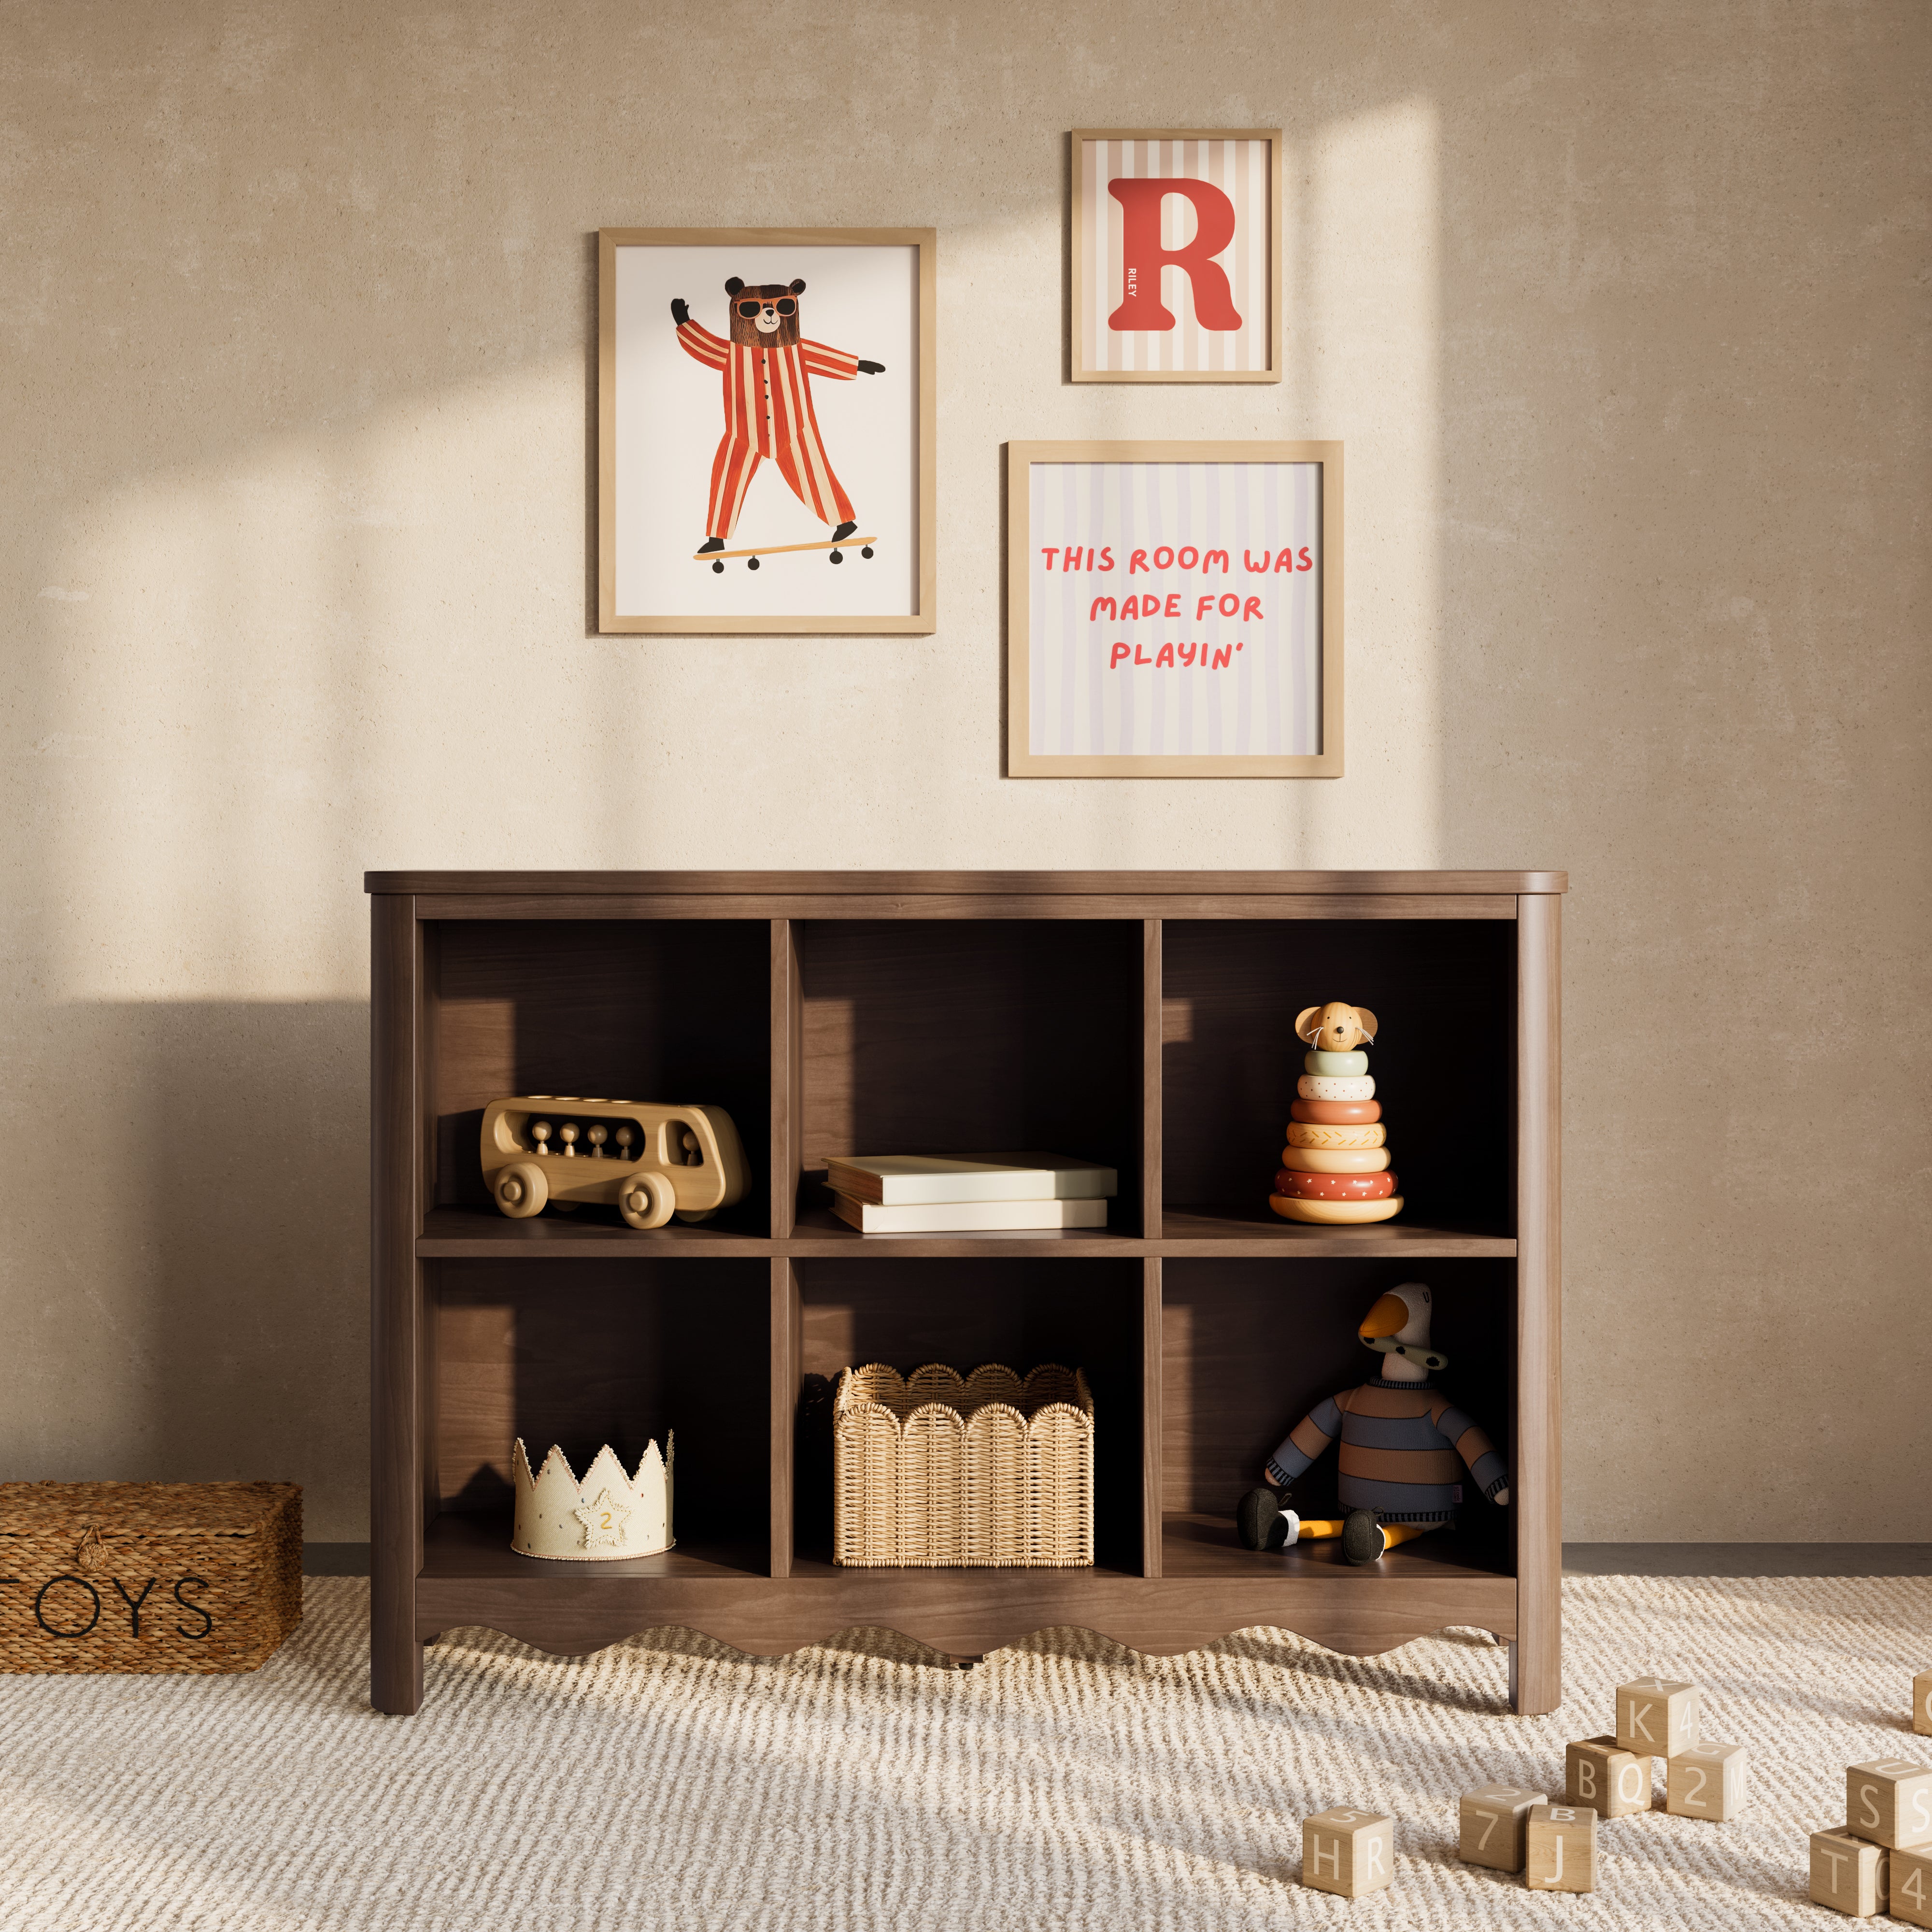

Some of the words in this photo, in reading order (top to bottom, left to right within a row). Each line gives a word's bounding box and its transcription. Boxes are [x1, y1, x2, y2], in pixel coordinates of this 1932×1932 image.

[1108, 178, 1243, 331] R
[1128, 268, 1136, 297] RILEY
[1041, 546, 1115, 572] THIS
[1129, 546, 1229, 575] ROOM
[1244, 546, 1313, 573] WAS
[1090, 594, 1181, 622] MADE
[1196, 593, 1264, 622] FOR
[1110, 642, 1243, 670] PLAYIN'
[601, 1512, 612, 1529] 2
[1637, 1679, 1681, 1692] X
[1630, 1700, 1655, 1742] K
[1680, 1701, 1693, 1739] 4
[1579, 1759, 1596, 1799] B
[1618, 1763, 1645, 1806] Q
[1684, 1766, 1707, 1807] 2
[1731, 1762, 1744, 1806] M
[1875, 1762, 1921, 1775] U
[1485, 1789, 1521, 1802] 2
[1550, 1808, 1576, 1821] B
[1860, 1785, 1880, 1829] S
[1912, 1788, 1930, 1833] S
[1329, 1810, 1370, 1823] 5
[1476, 1810, 1498, 1850] 7
[1314, 1834, 1339, 1880] H
[1368, 1836, 1386, 1880] R
[1545, 1835, 1563, 1883] J
[1821, 1848, 1848, 1894] T
[1901, 1868, 1926, 1911] 4
